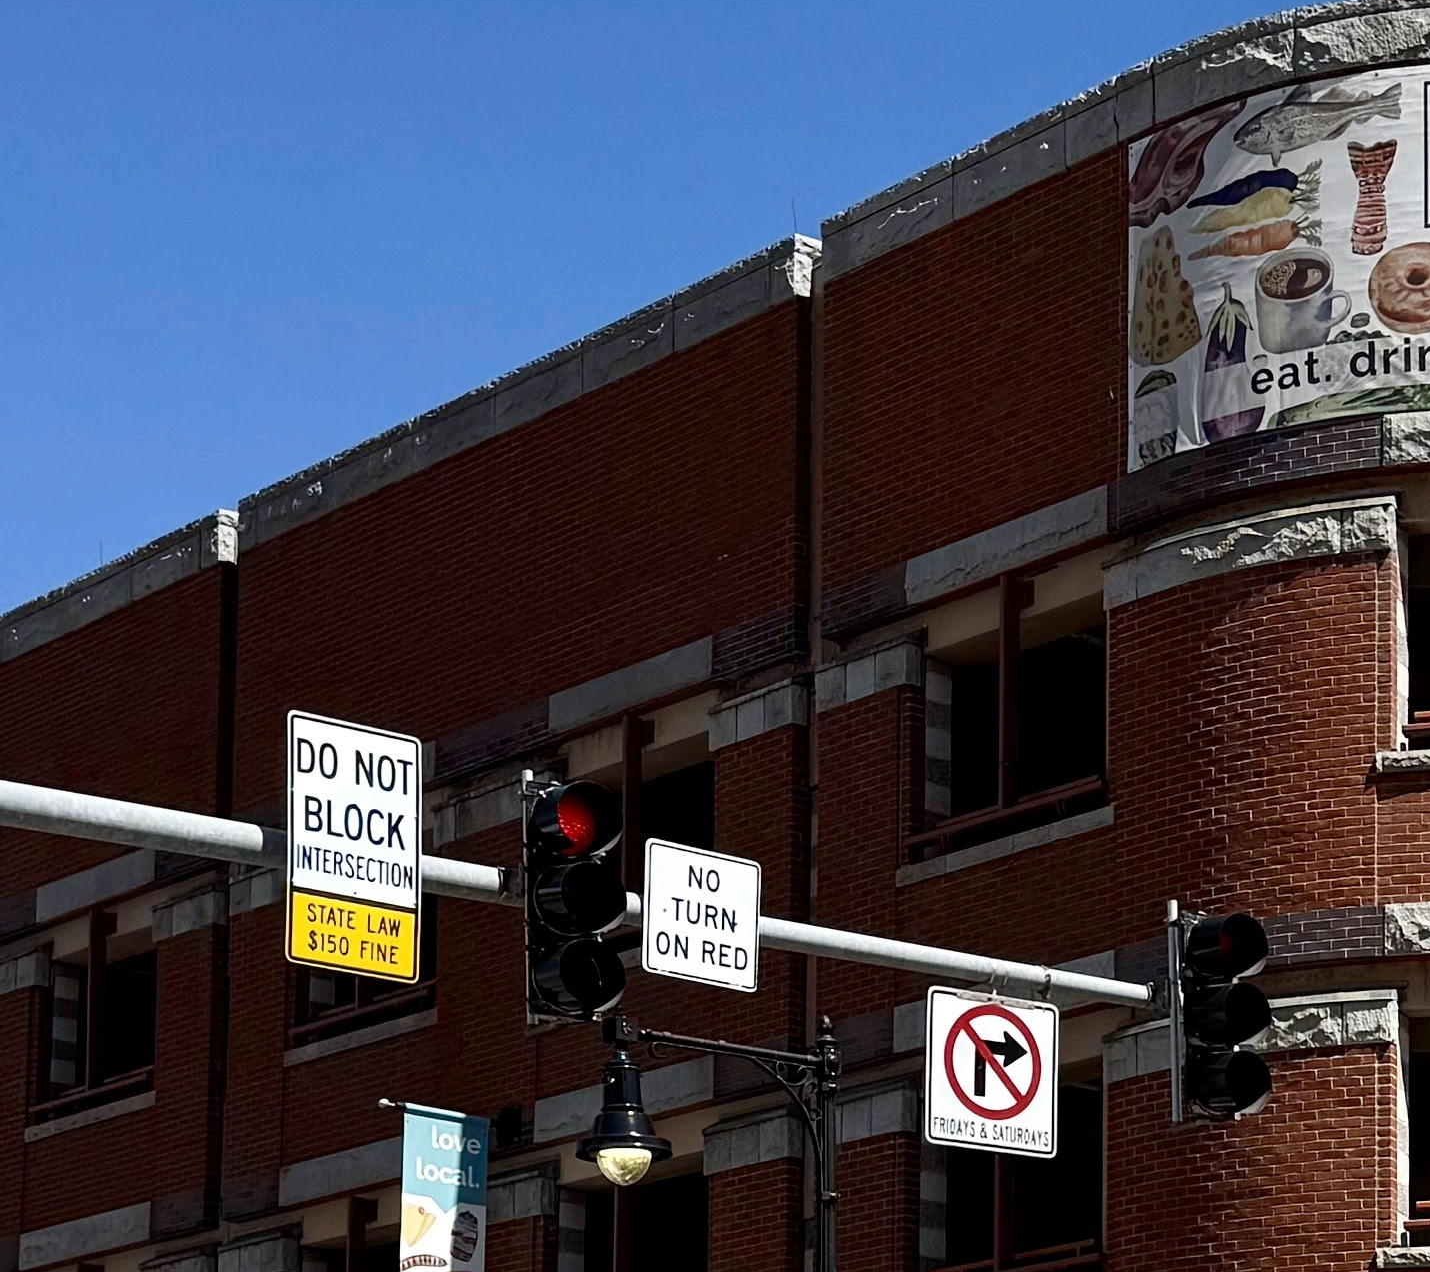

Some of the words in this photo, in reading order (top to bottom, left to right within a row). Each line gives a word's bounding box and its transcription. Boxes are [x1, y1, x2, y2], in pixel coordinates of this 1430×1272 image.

[1250, 356, 1333, 395] eat.
[297, 737, 339, 780] DO
[355, 749, 414, 796] NOT
[304, 794, 406, 851] BLOCK
[296, 843, 414, 891] INTERSECTION
[688, 864, 721, 893] NO
[307, 902, 357, 931] STATE
[367, 912, 402, 938] LAW
[671, 896, 736, 934] TURN
[307, 929, 350, 957] $150
[360, 940, 400, 965] FINE
[656, 931, 689, 960] ON
[702, 940, 748, 971] RED
[431, 1123, 482, 1155] love
[933, 1116, 976, 1138] FRIDAYS
[980, 1122, 988, 1139] &
[992, 1124, 1049, 1147] SATURDAYS
[416, 1155, 480, 1189] local.
